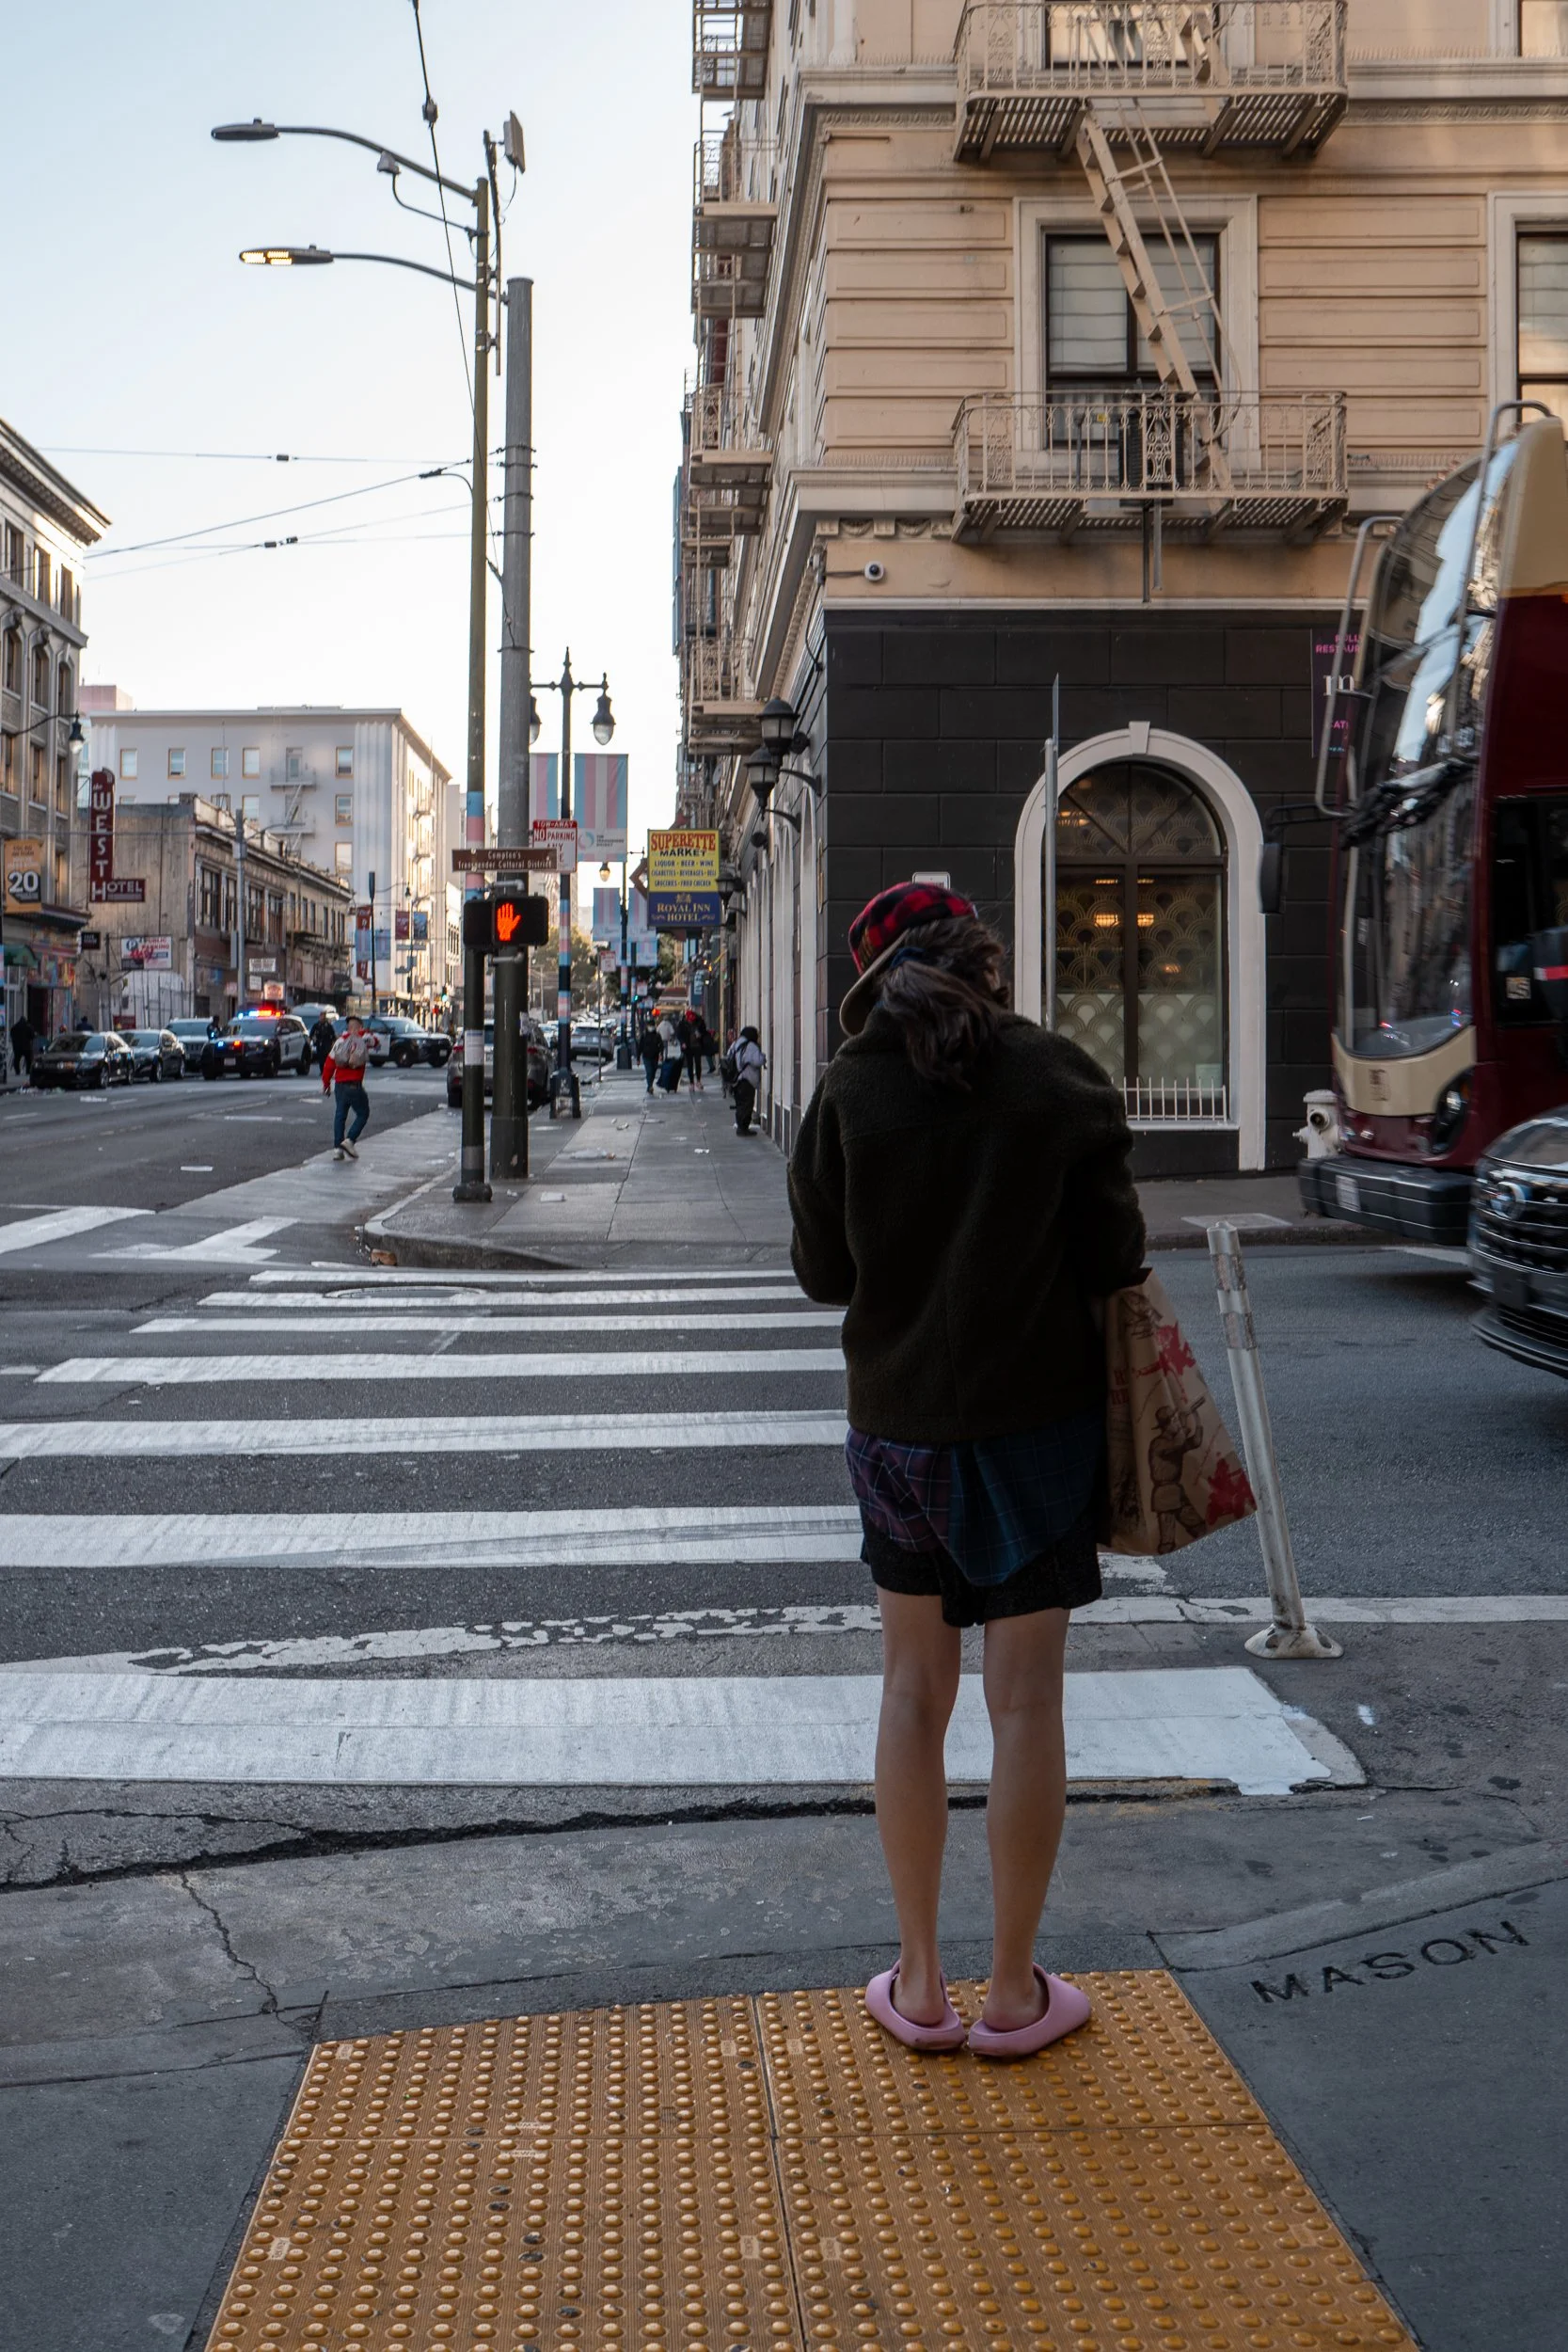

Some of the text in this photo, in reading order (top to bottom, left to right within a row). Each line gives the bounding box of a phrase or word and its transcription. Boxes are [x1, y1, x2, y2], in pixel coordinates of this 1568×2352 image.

[94, 791, 111, 878] WEST
[533, 829, 575, 841] NO PARKING
[651, 833, 715, 850] SUPERETTE
[487, 850, 521, 860] Compton's
[660, 848, 706, 856] MARKET
[8, 870, 39, 893] 20
[91, 881, 143, 901] HOTEL
[657, 903, 710, 913] ROYAL INN
[667, 914, 701, 922] HOTEL
[1250, 1920, 1530, 2004] MASON
